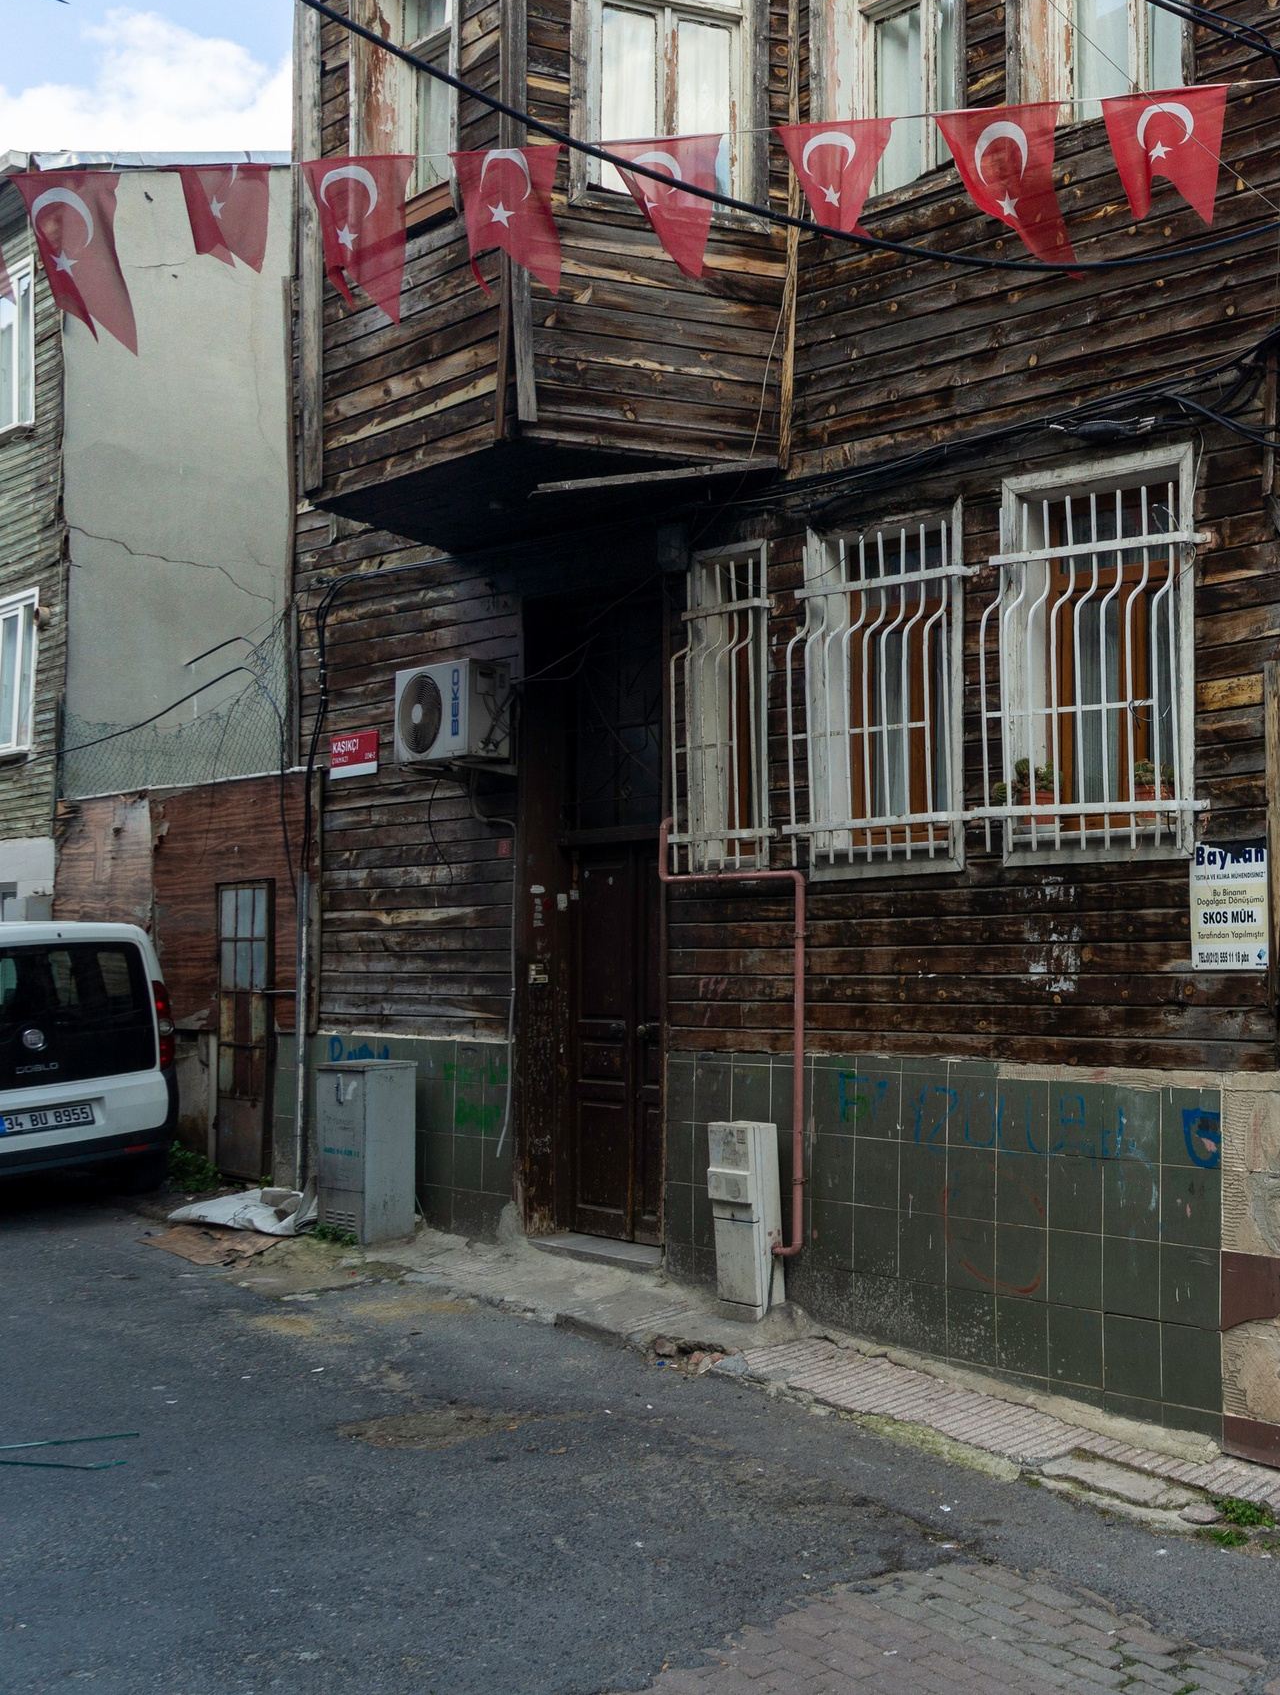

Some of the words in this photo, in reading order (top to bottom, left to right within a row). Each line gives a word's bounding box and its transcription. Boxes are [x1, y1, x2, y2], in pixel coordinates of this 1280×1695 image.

[451, 668, 460, 736] BEKO
[332, 738, 359, 755] KAŞIKÇI
[1212, 889, 1221, 897] Bu
[1222, 888, 1247, 897] Binanın
[1196, 896, 1227, 908] Doğalgaz
[1228, 894, 1265, 906] Dönüşümü
[1202, 910, 1229, 925] SKOS
[1231, 908, 1257, 924] MÜH.
[1197, 930, 1230, 940] Tarafından
[1231, 929, 1265, 940] Yapılmıştır
[15, 1062, 59, 1074] DOBLO
[4, 1117, 24, 1131] 34
[29, 1112, 48, 1127] BU
[54, 1106, 90, 1124] 8955
